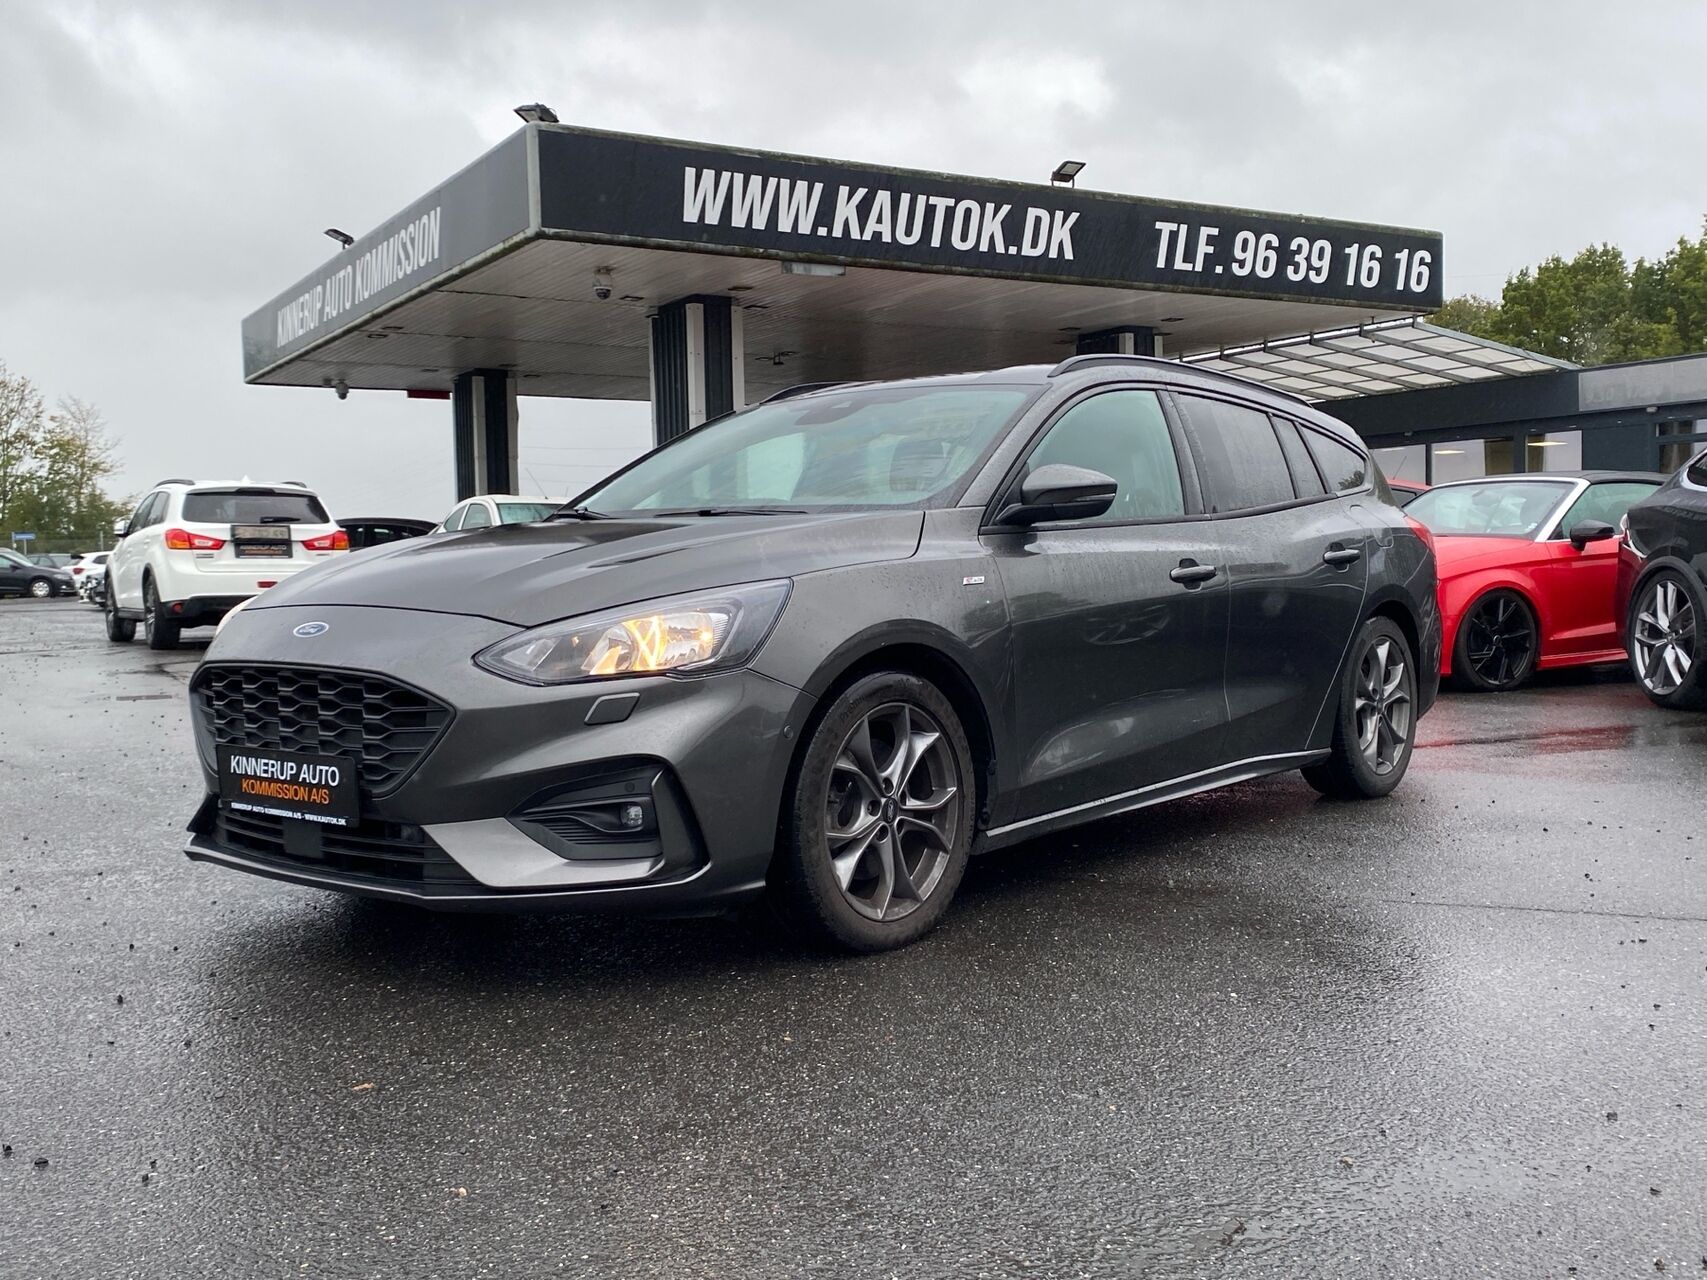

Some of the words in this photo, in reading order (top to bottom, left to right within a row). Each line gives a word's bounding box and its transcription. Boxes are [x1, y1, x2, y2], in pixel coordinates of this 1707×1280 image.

[682, 166, 1081, 261] WWW.KAUTOK.DK
[277, 285, 323, 348] KINNERUP
[323, 264, 352, 322] AUTO
[355, 206, 441, 304] KOMMISSION
[1155, 221, 1223, 274] TLF.
[1231, 230, 1280, 279] 96
[1287, 236, 1332, 285] 39
[1344, 242, 1383, 289] 16
[1395, 248, 1432, 293] 16
[230, 755, 296, 781] KINNERUP
[299, 764, 340, 787] AUTO
[242, 779, 308, 801] KOMMISSION
[310, 787, 330, 804] A/S
